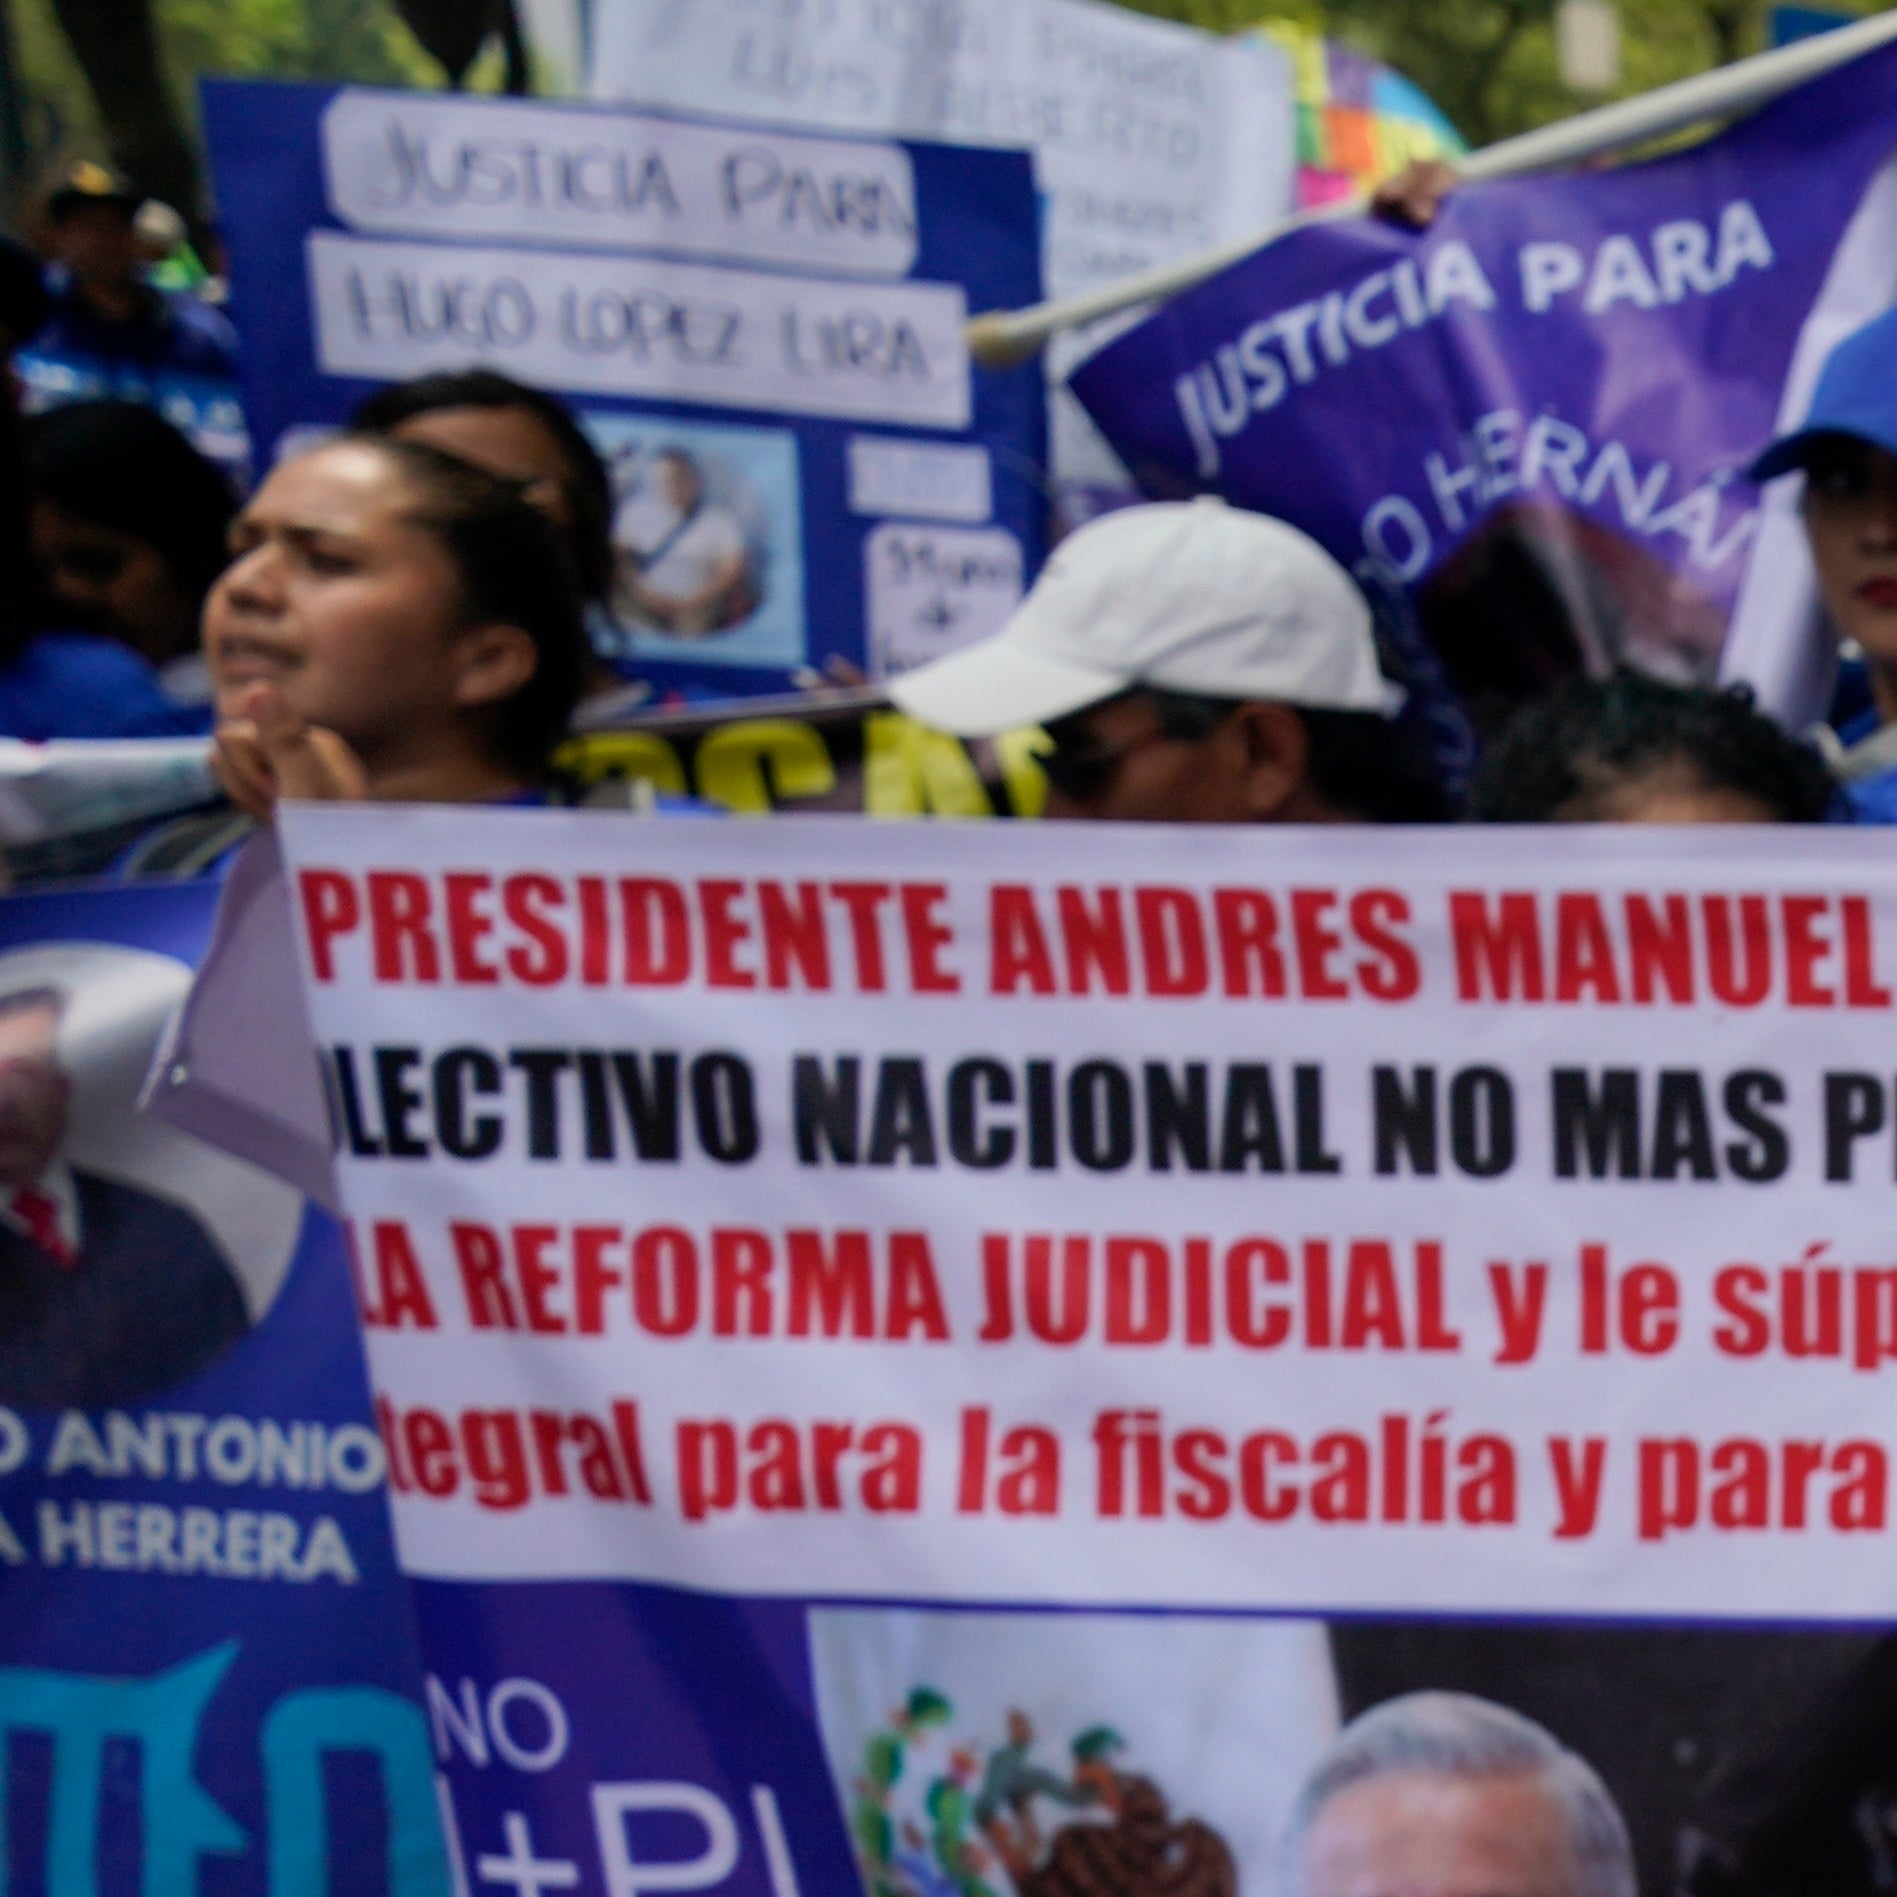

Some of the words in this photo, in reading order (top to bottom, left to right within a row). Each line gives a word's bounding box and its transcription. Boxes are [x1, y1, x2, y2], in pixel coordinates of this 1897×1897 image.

[370, 120, 682, 220] JUSTICIA
[718, 144, 914, 236] PARA
[342, 262, 537, 352] HUGO
[558, 284, 745, 366] LOPEZ
[780, 304, 932, 383] LIRA
[1174, 242, 1497, 477] JUSTICIA
[1520, 200, 1774, 313] PARA
[297, 866, 962, 996] PRESIDENTE
[988, 881, 1422, 1001] ANDRES
[1448, 888, 1892, 1011] MANUEL
[318, 1045, 763, 1168] LECTIVO
[793, 1054, 1340, 1177] NACIONAL
[1371, 1062, 1518, 1180] NO
[1548, 1066, 1792, 1185] MAS
[448, 1220, 950, 1344] REFORMA
[976, 1234, 1461, 1354] JUDICIAL
[1487, 1261, 1549, 1367] y
[1578, 1243, 1682, 1358] le
[48, 1410, 386, 1495] ANTONIO
[675, 1416, 923, 1525] para
[954, 1404, 1062, 1518] la
[1092, 1404, 1519, 1526] fiscalía
[1547, 1432, 1607, 1543] y
[1635, 1432, 1890, 1544] para
[38, 1499, 362, 1586] HERRERA
[426, 1673, 569, 1772] NO
